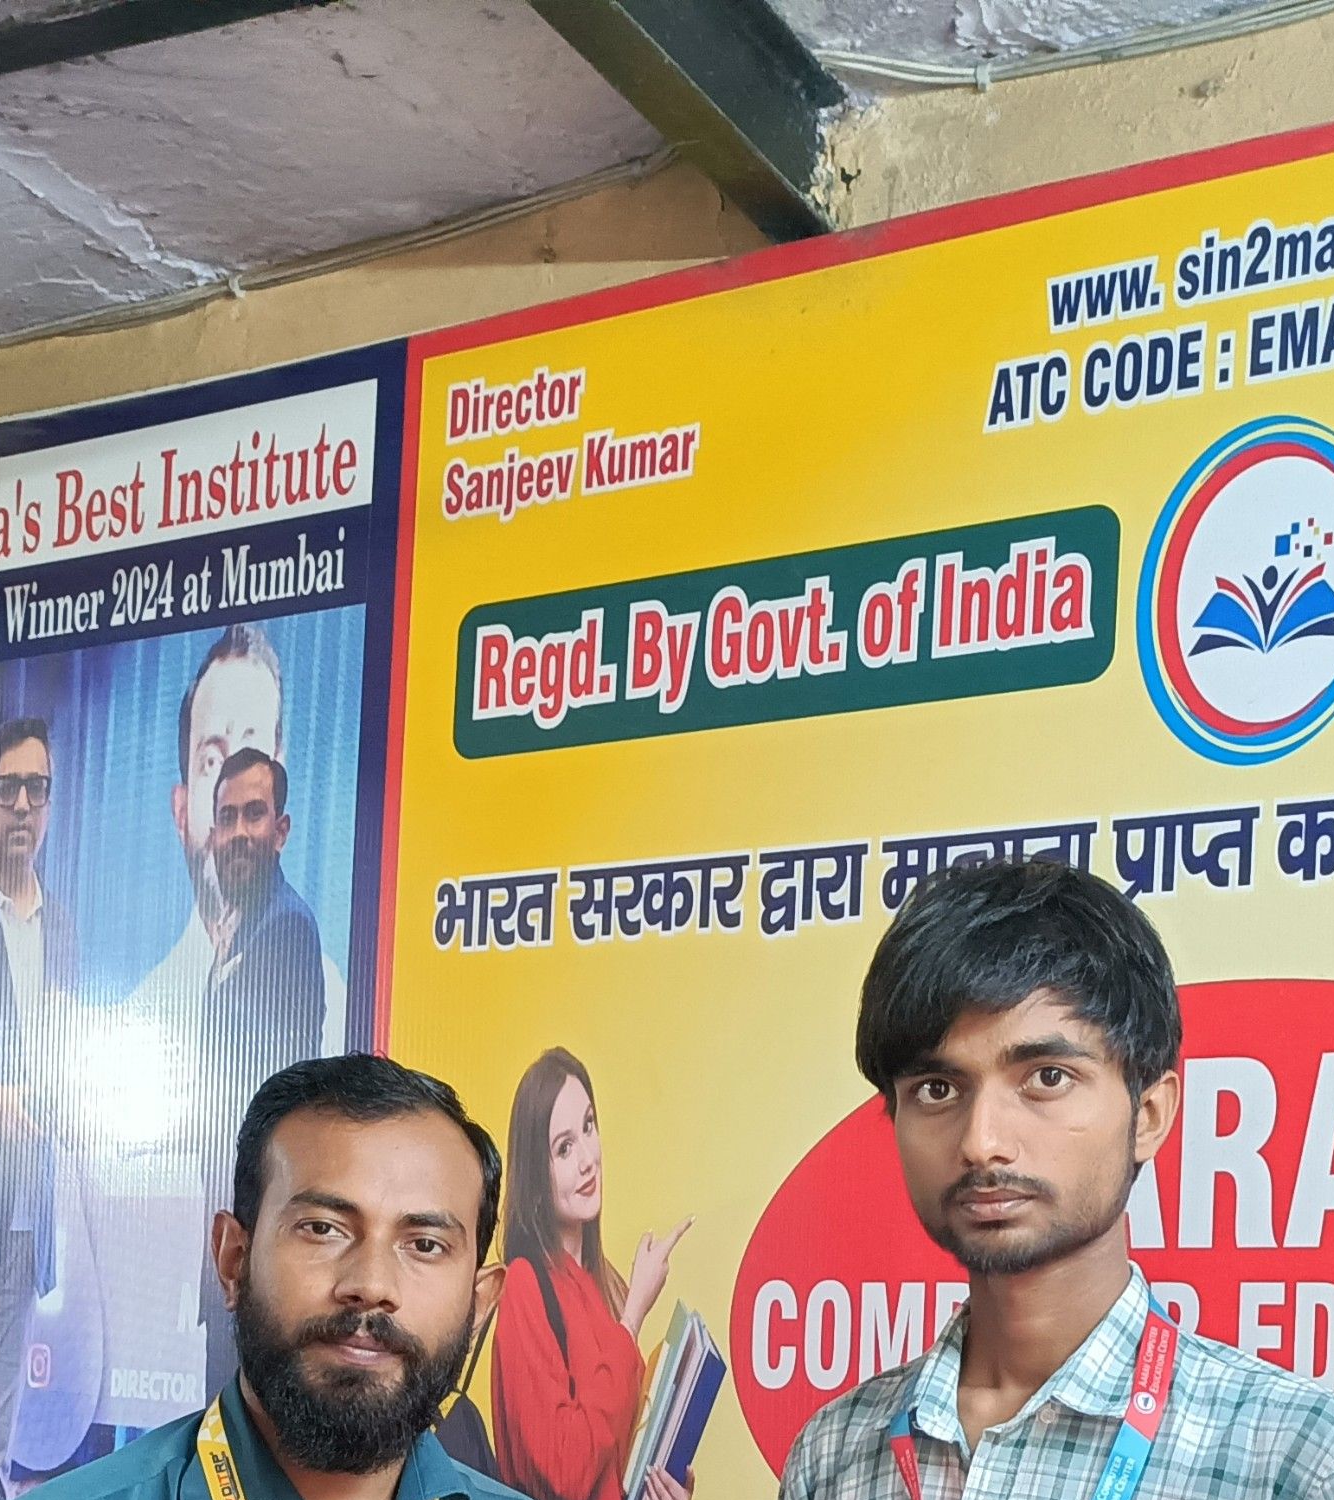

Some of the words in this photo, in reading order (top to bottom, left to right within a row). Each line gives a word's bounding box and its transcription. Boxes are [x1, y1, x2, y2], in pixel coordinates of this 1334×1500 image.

[1051, 264, 1160, 327] www.
[449, 371, 581, 438] Director
[988, 357, 1068, 426] ATC
[1084, 329, 1203, 408] CODE
[53, 460, 145, 548] Best
[158, 422, 358, 528] Institute
[445, 450, 572, 520] Sanjeev
[584, 425, 697, 488] Kumar
[4, 568, 105, 638] Winner
[110, 560, 175, 622] 2024
[181, 566, 213, 616] at
[219, 526, 346, 610] Mumbai
[478, 609, 613, 721] Regd.
[629, 594, 693, 705] By
[710, 579, 842, 680] Govt.
[864, 564, 922, 661] of
[939, 540, 1085, 645] India
[435, 873, 557, 949] भारत
[567, 852, 748, 938] सरकार
[759, 843, 868, 935] द्वारा
[1113, 806, 1260, 899] प्राप्त
[110, 1368, 197, 1403] DIRECTOR
